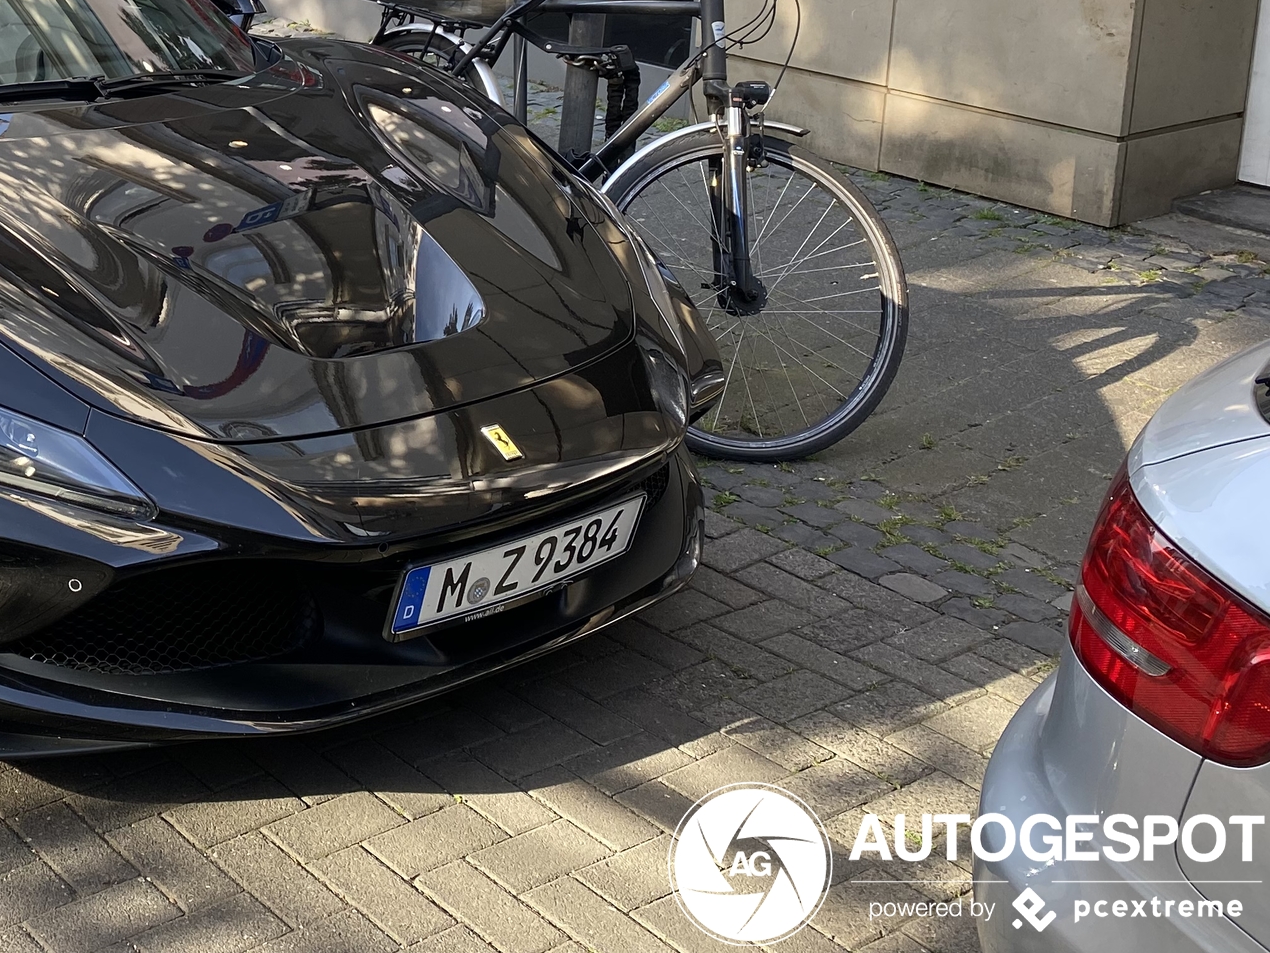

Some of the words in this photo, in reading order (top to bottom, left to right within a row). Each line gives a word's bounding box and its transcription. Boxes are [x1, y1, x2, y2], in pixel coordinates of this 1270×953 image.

[436, 561, 472, 613] M
[493, 545, 527, 596] Z
[531, 508, 624, 584] 9384
[403, 604, 414, 620] D
